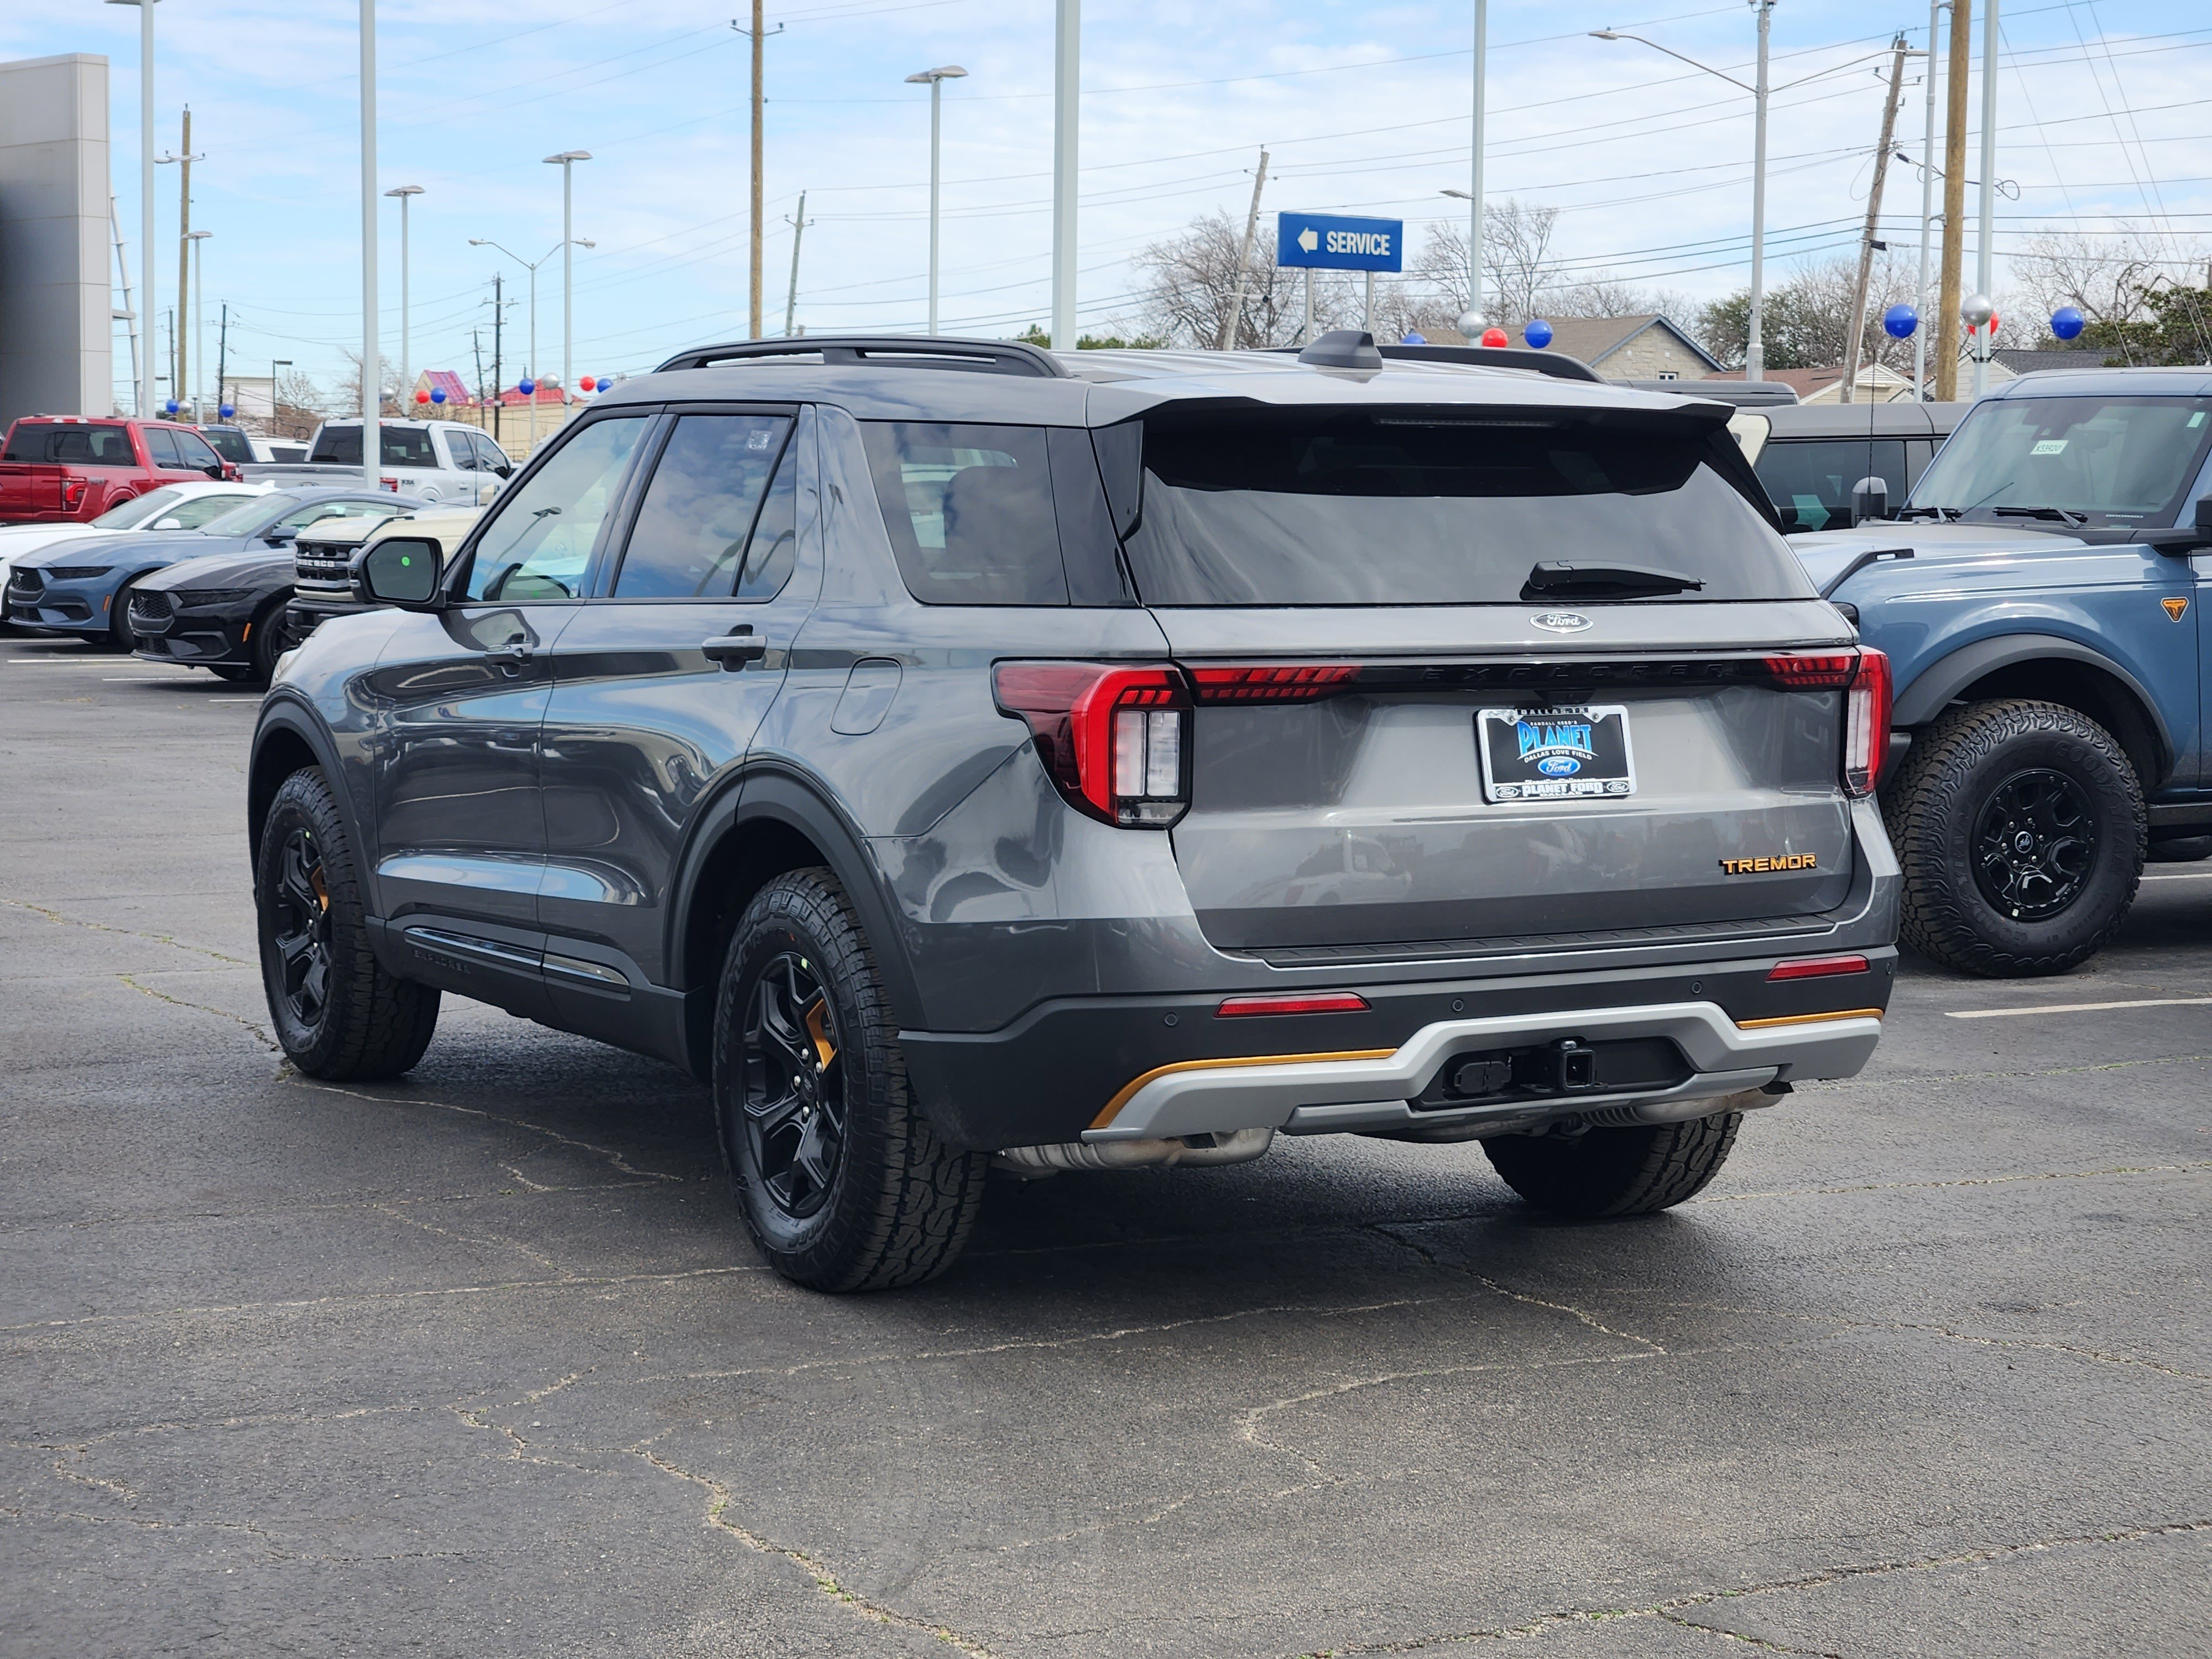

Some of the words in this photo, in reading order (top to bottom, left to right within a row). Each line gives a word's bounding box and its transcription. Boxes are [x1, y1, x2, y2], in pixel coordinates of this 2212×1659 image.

[1326, 231, 1391, 256] SERVICE
[1546, 614, 1580, 626] Ford
[1419, 664, 1724, 680] EXPLORER
[1516, 721, 1593, 757] PLANET
[1524, 751, 1550, 763] DALLAS
[1571, 750, 1593, 760] FIELD
[1546, 759, 1572, 773] Ford
[1521, 784, 1568, 797] PLANET
[1570, 781, 1604, 794] FORD
[1719, 853, 1817, 875] TREMOR
